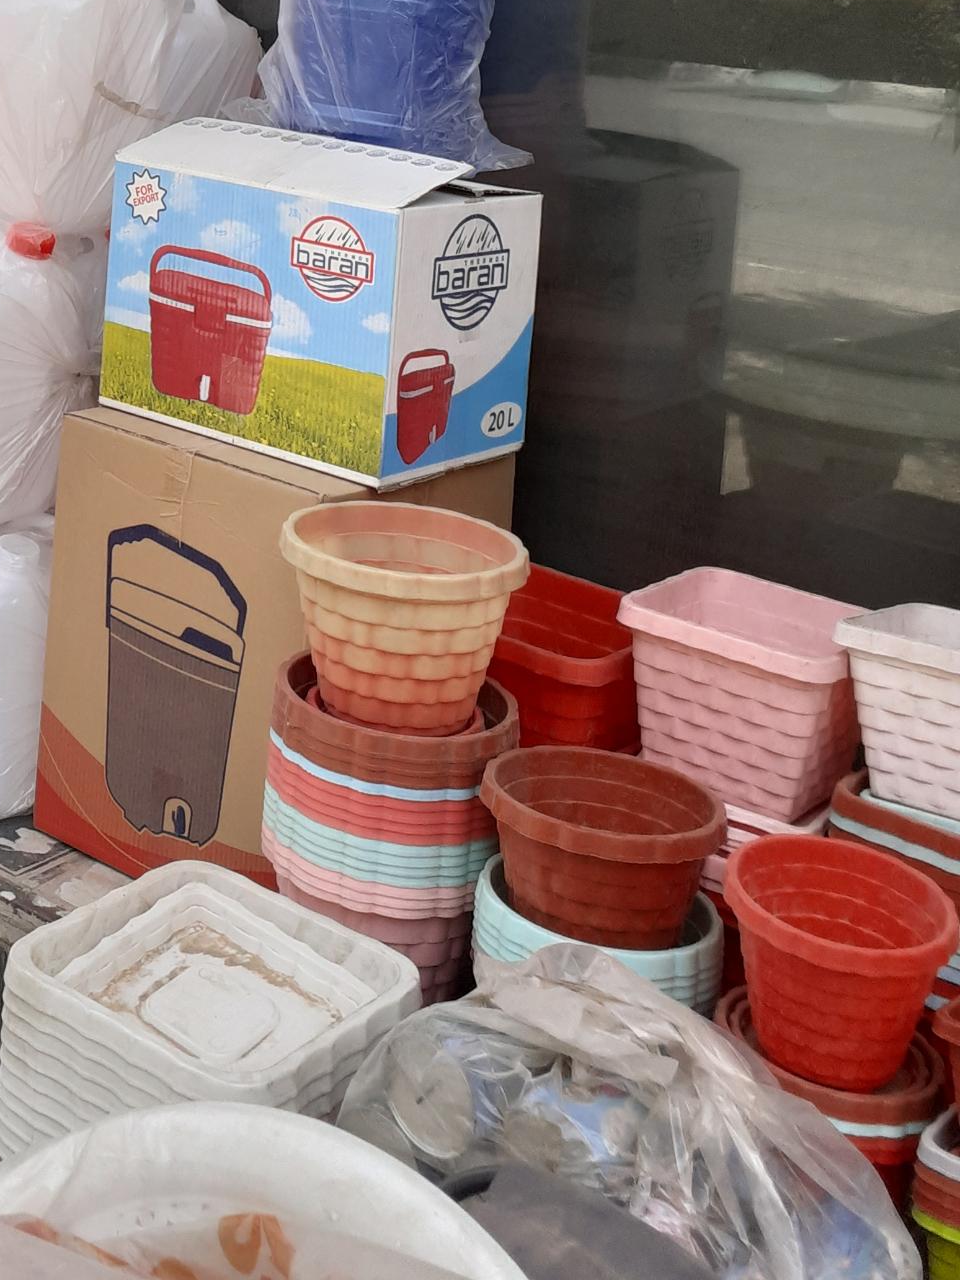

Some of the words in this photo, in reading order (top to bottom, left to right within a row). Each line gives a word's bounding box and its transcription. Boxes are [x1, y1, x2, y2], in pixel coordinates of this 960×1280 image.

[133, 192, 160, 207] EXPORT
[135, 183, 154, 196] FOR
[296, 244, 371, 279] baran
[436, 262, 505, 293] baran
[487, 412, 505, 433] 20
[507, 407, 515, 427] L
